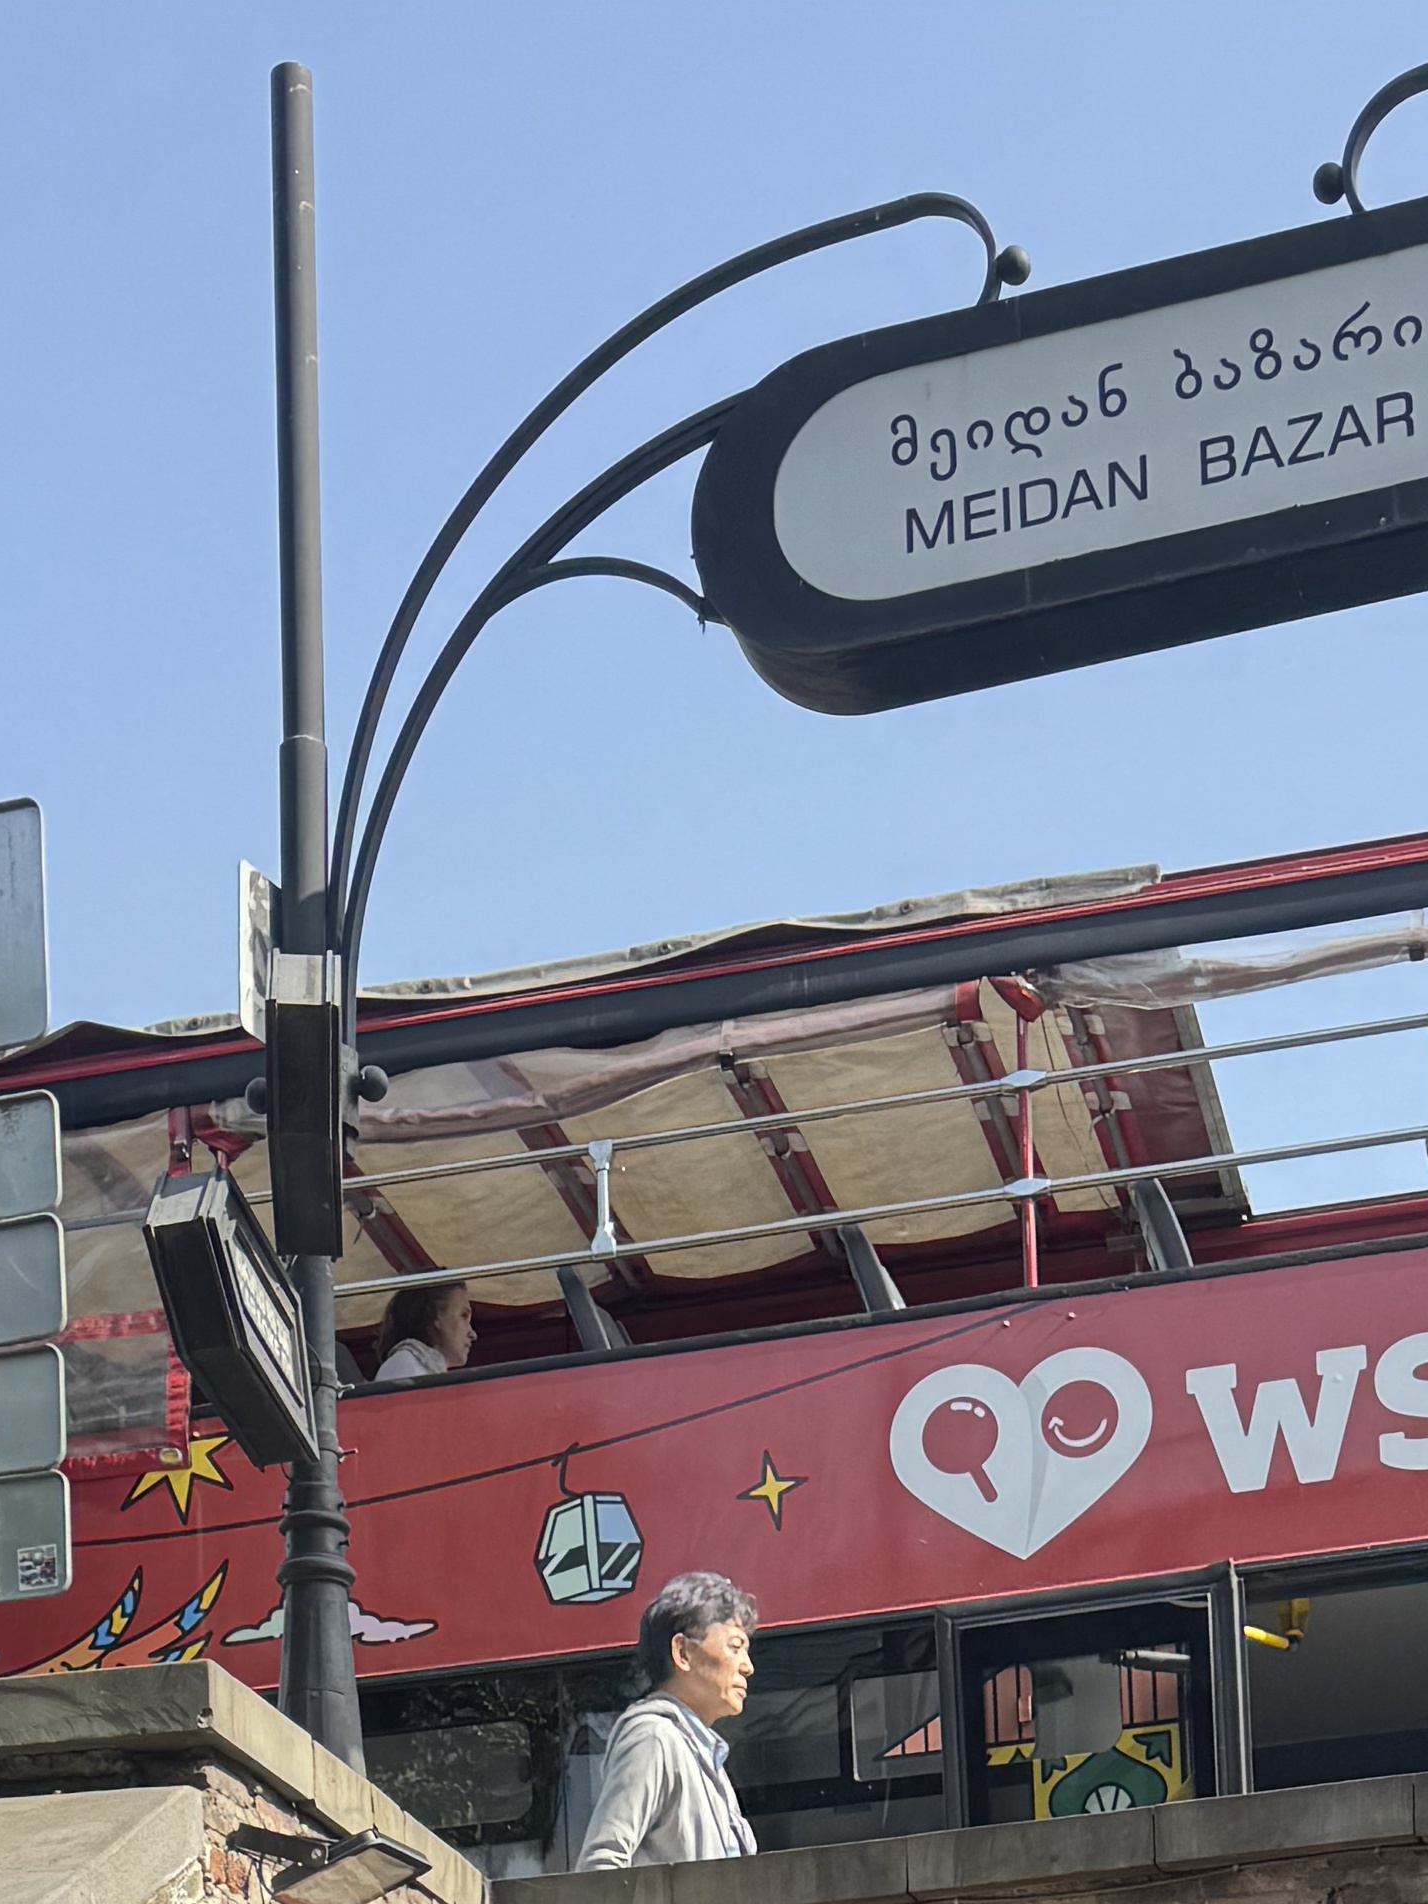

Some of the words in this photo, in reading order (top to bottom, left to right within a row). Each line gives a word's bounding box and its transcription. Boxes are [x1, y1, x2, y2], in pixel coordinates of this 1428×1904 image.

[890, 364, 1127, 481] მეიდან
[1173, 302, 1423, 398] ბაზარი
[906, 454, 1149, 553] MEIDAN
[1199, 391, 1414, 487] BAZAR
